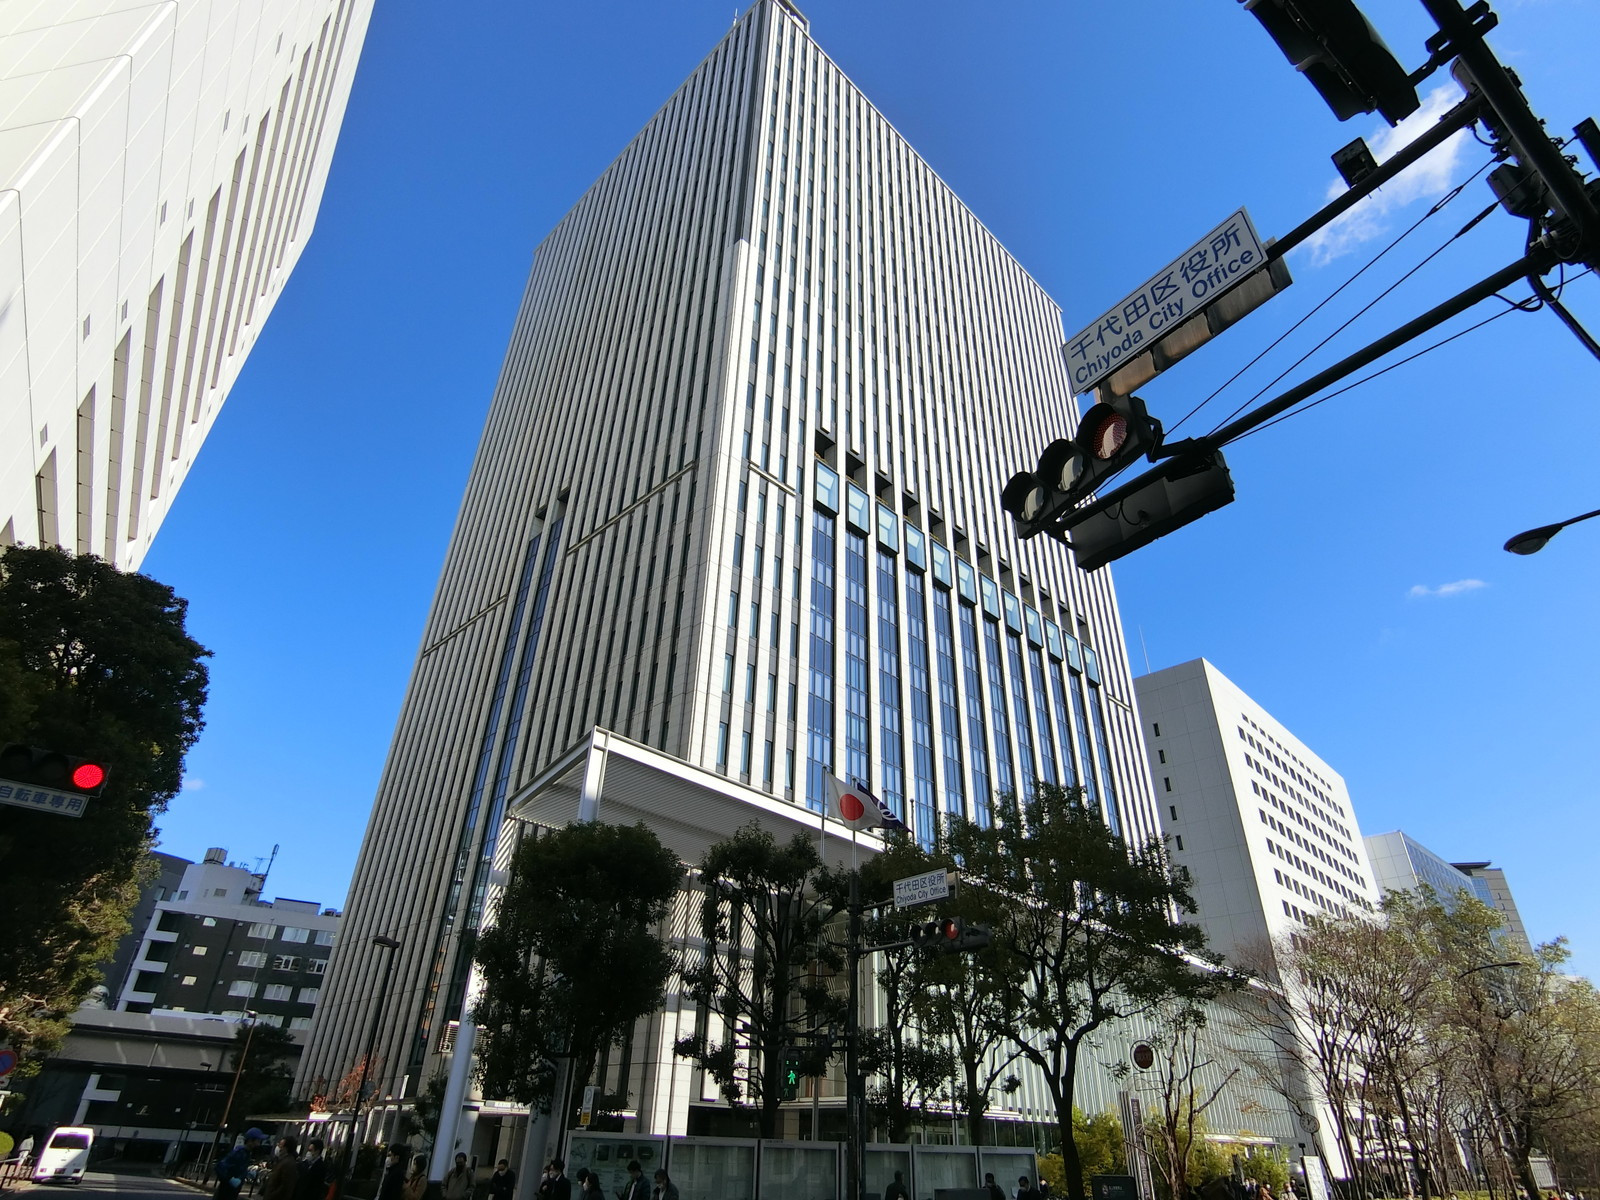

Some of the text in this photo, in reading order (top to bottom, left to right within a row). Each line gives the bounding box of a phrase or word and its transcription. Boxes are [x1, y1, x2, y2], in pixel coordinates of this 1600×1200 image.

[1071, 222, 1241, 361] 千代田区役所
[1075, 250, 1254, 384] Chiyoda City Office
[0, 785, 83, 811] 自転車専用
[896, 872, 945, 894] 千代田区役所
[896, 886, 946, 904] Chiyoda City Office
